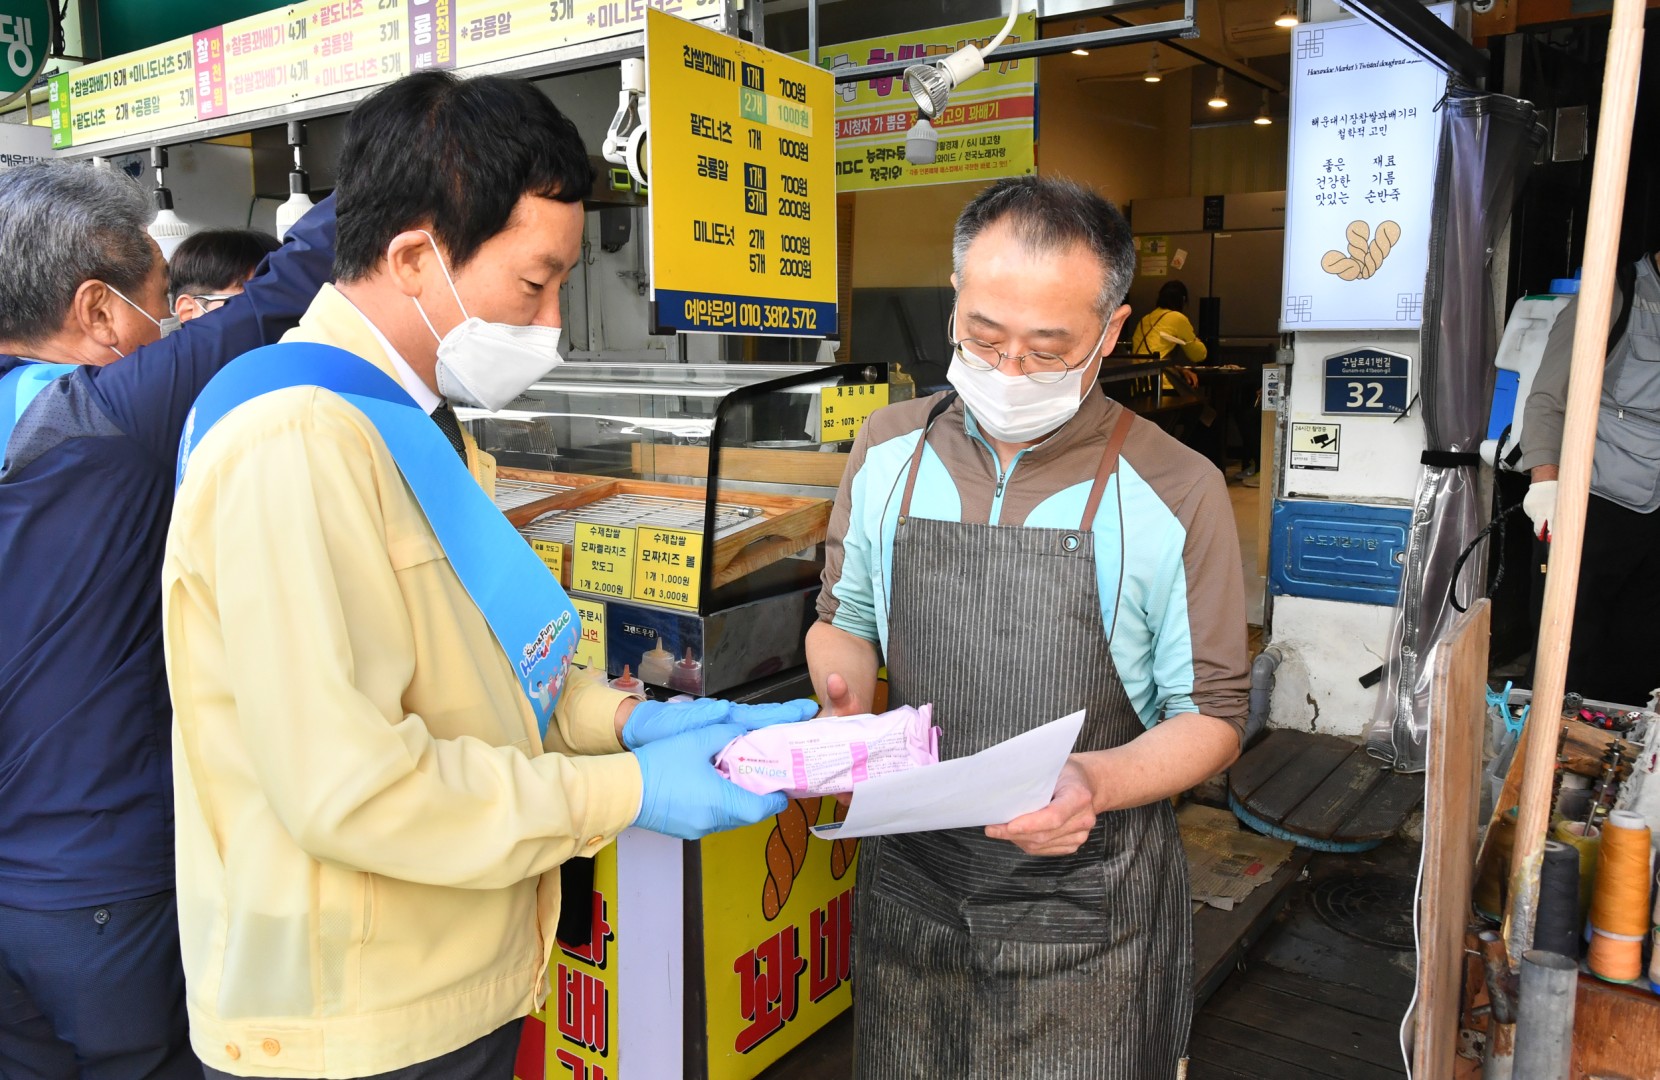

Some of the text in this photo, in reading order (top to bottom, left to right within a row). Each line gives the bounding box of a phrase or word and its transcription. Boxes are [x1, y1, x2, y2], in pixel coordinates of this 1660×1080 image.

[321, 0, 363, 26] 팥도너츠
[550, 0, 574, 22] 3개
[231, 18, 306, 56] 찰콩꽈배기 4개
[470, 11, 512, 42] 공룡알
[321, 20, 399, 57] 공룡알 3개
[323, 52, 400, 86] 미니도너츠 5개
[415, 52, 432, 68] 세트
[75, 72, 111, 97] 찹쌀꽈배기
[114, 68, 126, 87] 8개
[133, 55, 176, 82] 미니도너츠
[177, 50, 192, 70] 5개
[234, 59, 308, 95] 찹쌀꽈배기 4개
[683, 45, 806, 103] 찹쌀꽈배기 1개 700원
[77, 87, 194, 130] 팥도너츠 2개 공룡알 3개
[744, 93, 809, 129] 2개 1000원
[843, 118, 871, 135] 시청자
[874, 118, 883, 132] 가
[886, 114, 907, 130] 뽑은
[969, 102, 999, 121] 꽈배기
[690, 113, 809, 162] 팥도너츠 1개 1000원
[1369, 124, 1387, 136] 고민
[936, 140, 958, 150] 활경제
[967, 138, 977, 147] 6시
[979, 135, 1001, 146] 내고향
[934, 153, 956, 164] 와이드
[965, 147, 1006, 160] 전국노래자랑
[1323, 155, 1396, 173] 좋은 재료
[697, 155, 807, 197] 공룡알 1개 700원
[1316, 171, 1395, 189] 건강한 기름
[748, 192, 810, 221] 3개 2000원
[1315, 188, 1400, 206] 맛있는 손반죽
[694, 220, 810, 256] 미니도넛 2개 1000원
[750, 254, 811, 279] 5개 2000원
[684, 299, 736, 327] 예약문의
[764, 305, 789, 328] 3812
[792, 307, 816, 329] 5712
[1342, 357, 1390, 368] 구남로41번길
[1346, 382, 1384, 408] 32
[590, 526, 621, 539] 수제찹쌀
[654, 533, 686, 546] 수제찹쌀
[592, 560, 614, 572] 핫도그
[642, 550, 680, 565] 모짜치즈
[580, 580, 623, 595] 1개 2,000원
[645, 571, 690, 586] 1개 1,000원
[644, 587, 688, 602] 4개 3,000원
[579, 609, 602, 623] 주문시
[582, 628, 598, 640] 니언
[739, 765, 787, 777] ED Wipes
[733, 887, 855, 1054] 꽈배
